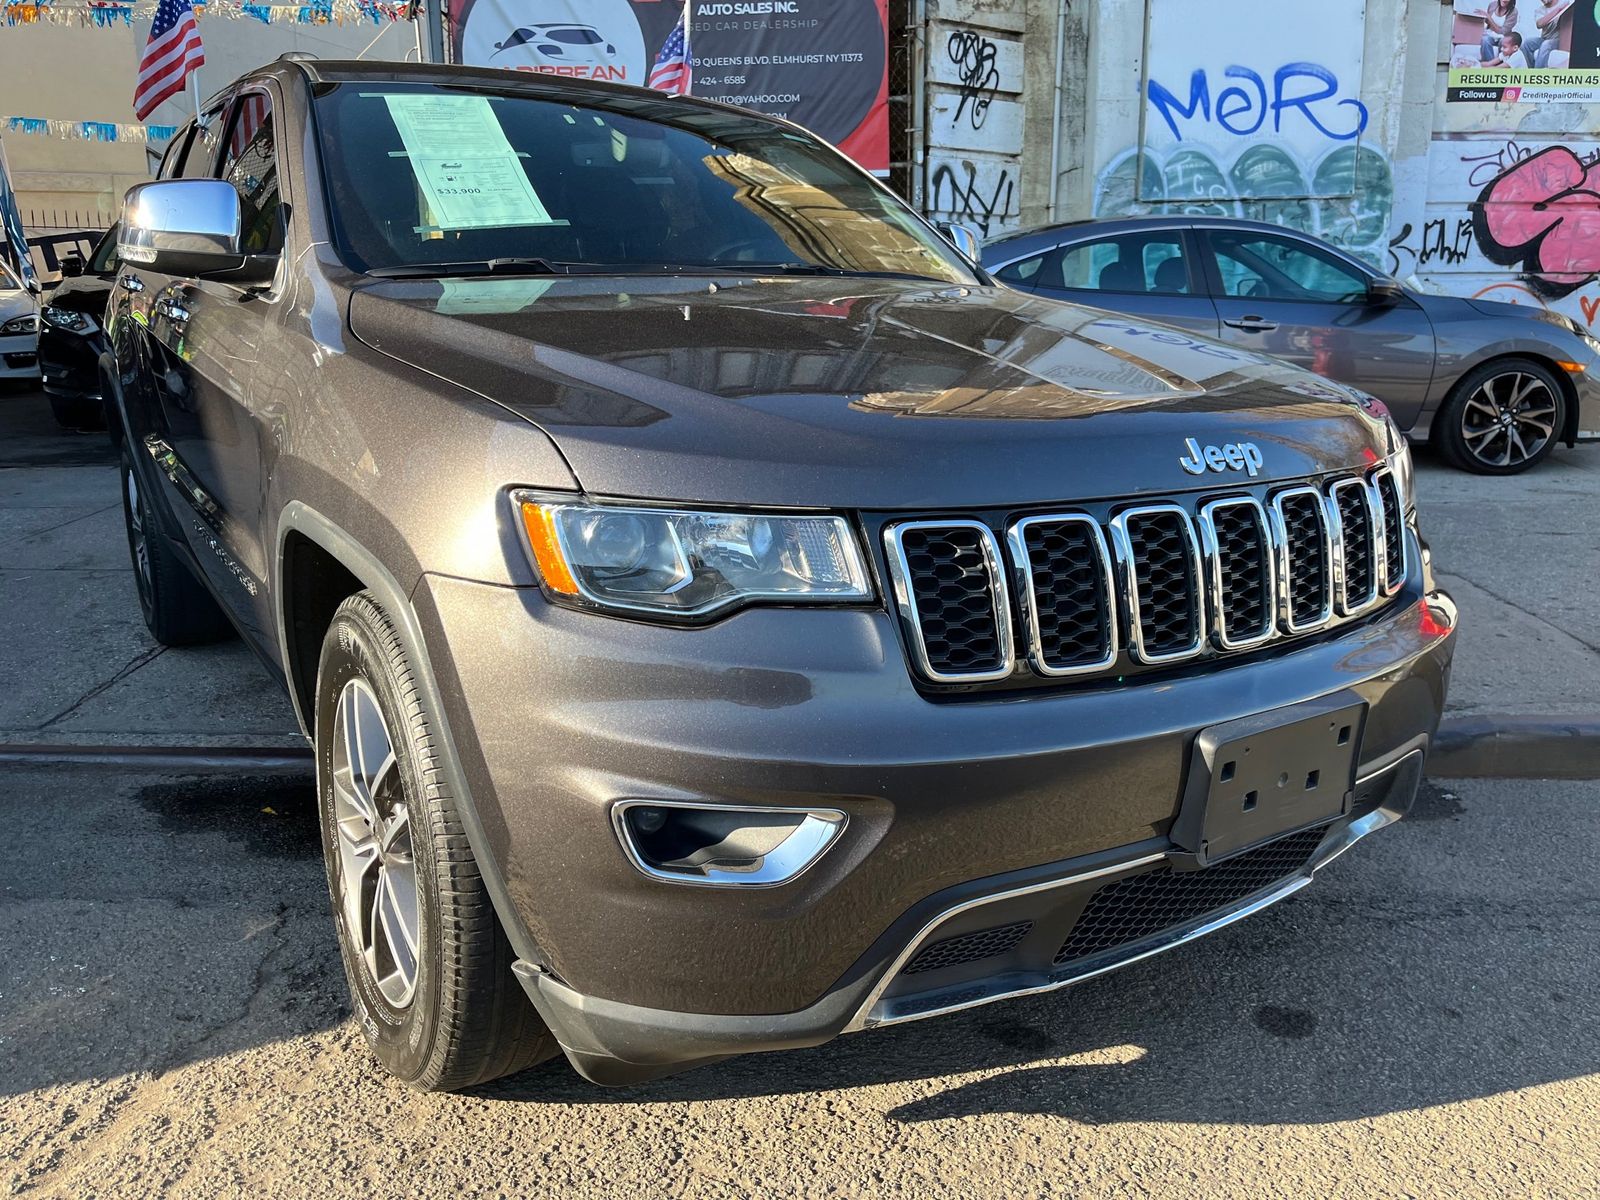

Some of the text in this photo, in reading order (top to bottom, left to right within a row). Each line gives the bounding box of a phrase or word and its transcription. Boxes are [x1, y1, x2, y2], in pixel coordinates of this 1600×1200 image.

[697, 1, 799, 16] AUTO SALES INC.
[689, 19, 819, 32] SED CAR DEALERSHIP
[692, 53, 863, 68] 19 QUEENS BLVD. ELMHURST NY 11373
[699, 76, 717, 86] 424
[723, 75, 746, 85] 6585
[1460, 74, 1600, 85] RESULTS IN LESS THAN 45
[702, 93, 801, 106] AUTO@YAHOO.COM
[1459, 90, 1486, 99] Follow
[1522, 91, 1593, 100] CreditRepairOfficial
[1179, 437, 1263, 477] Jeep
